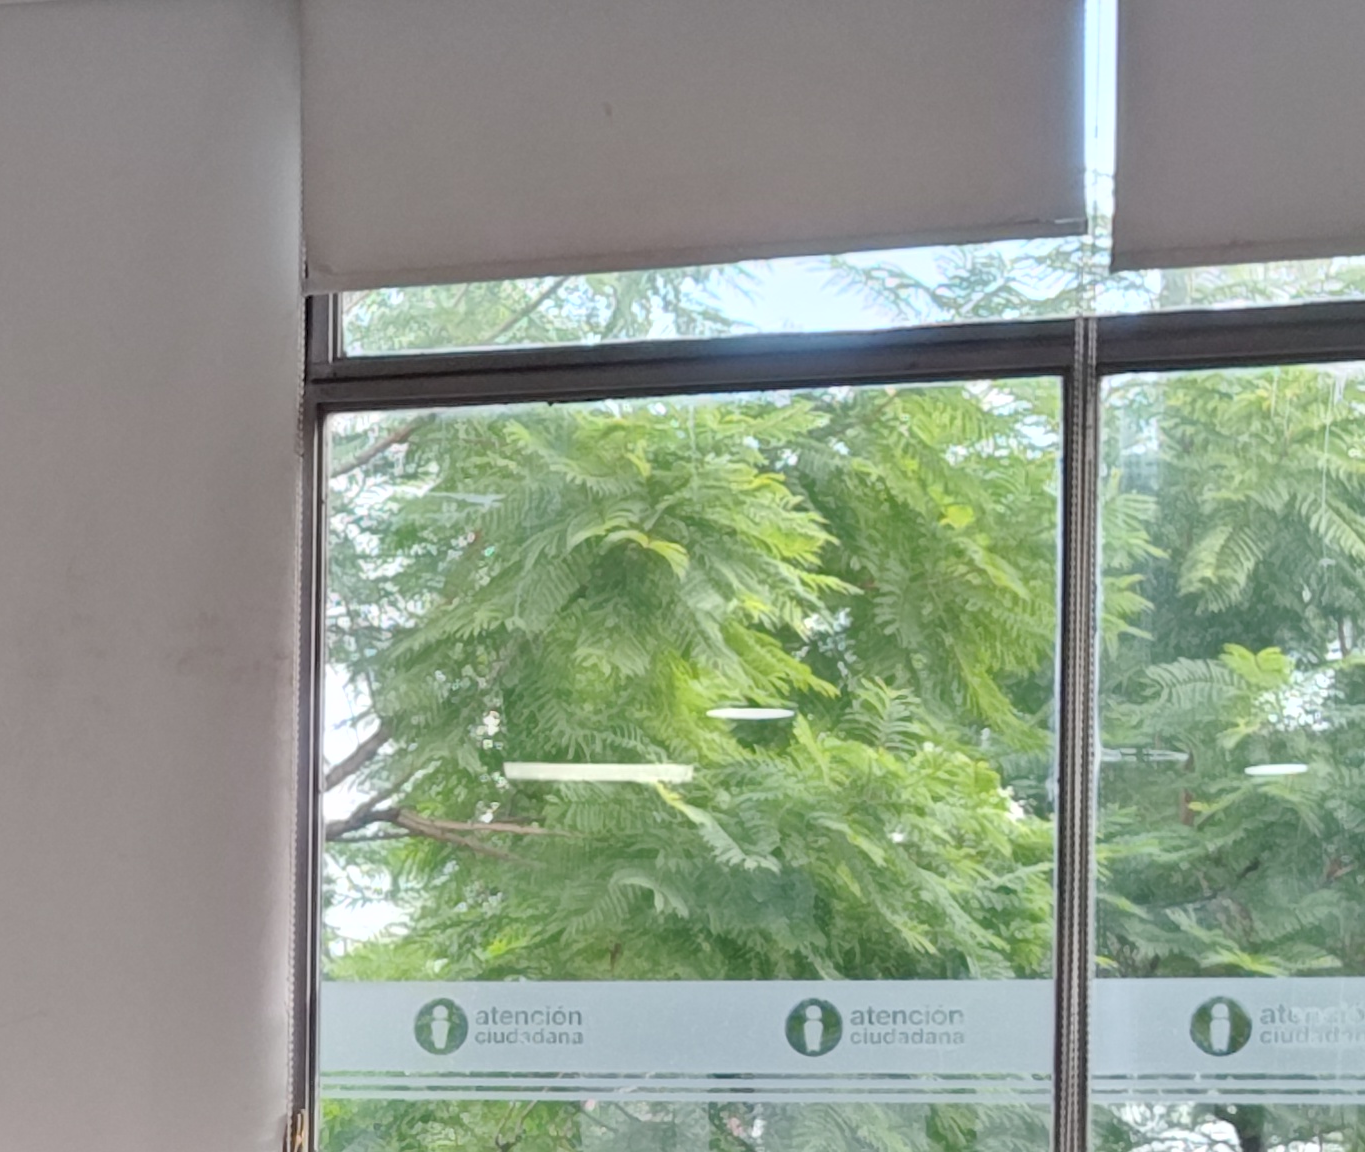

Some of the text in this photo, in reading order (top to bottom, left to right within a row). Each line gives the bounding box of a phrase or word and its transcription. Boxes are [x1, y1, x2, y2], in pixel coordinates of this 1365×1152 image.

[475, 1005, 583, 1026] atención
[849, 1004, 965, 1027] atención
[474, 1027, 585, 1046] ciudadana
[849, 1027, 966, 1045] ciudadana
